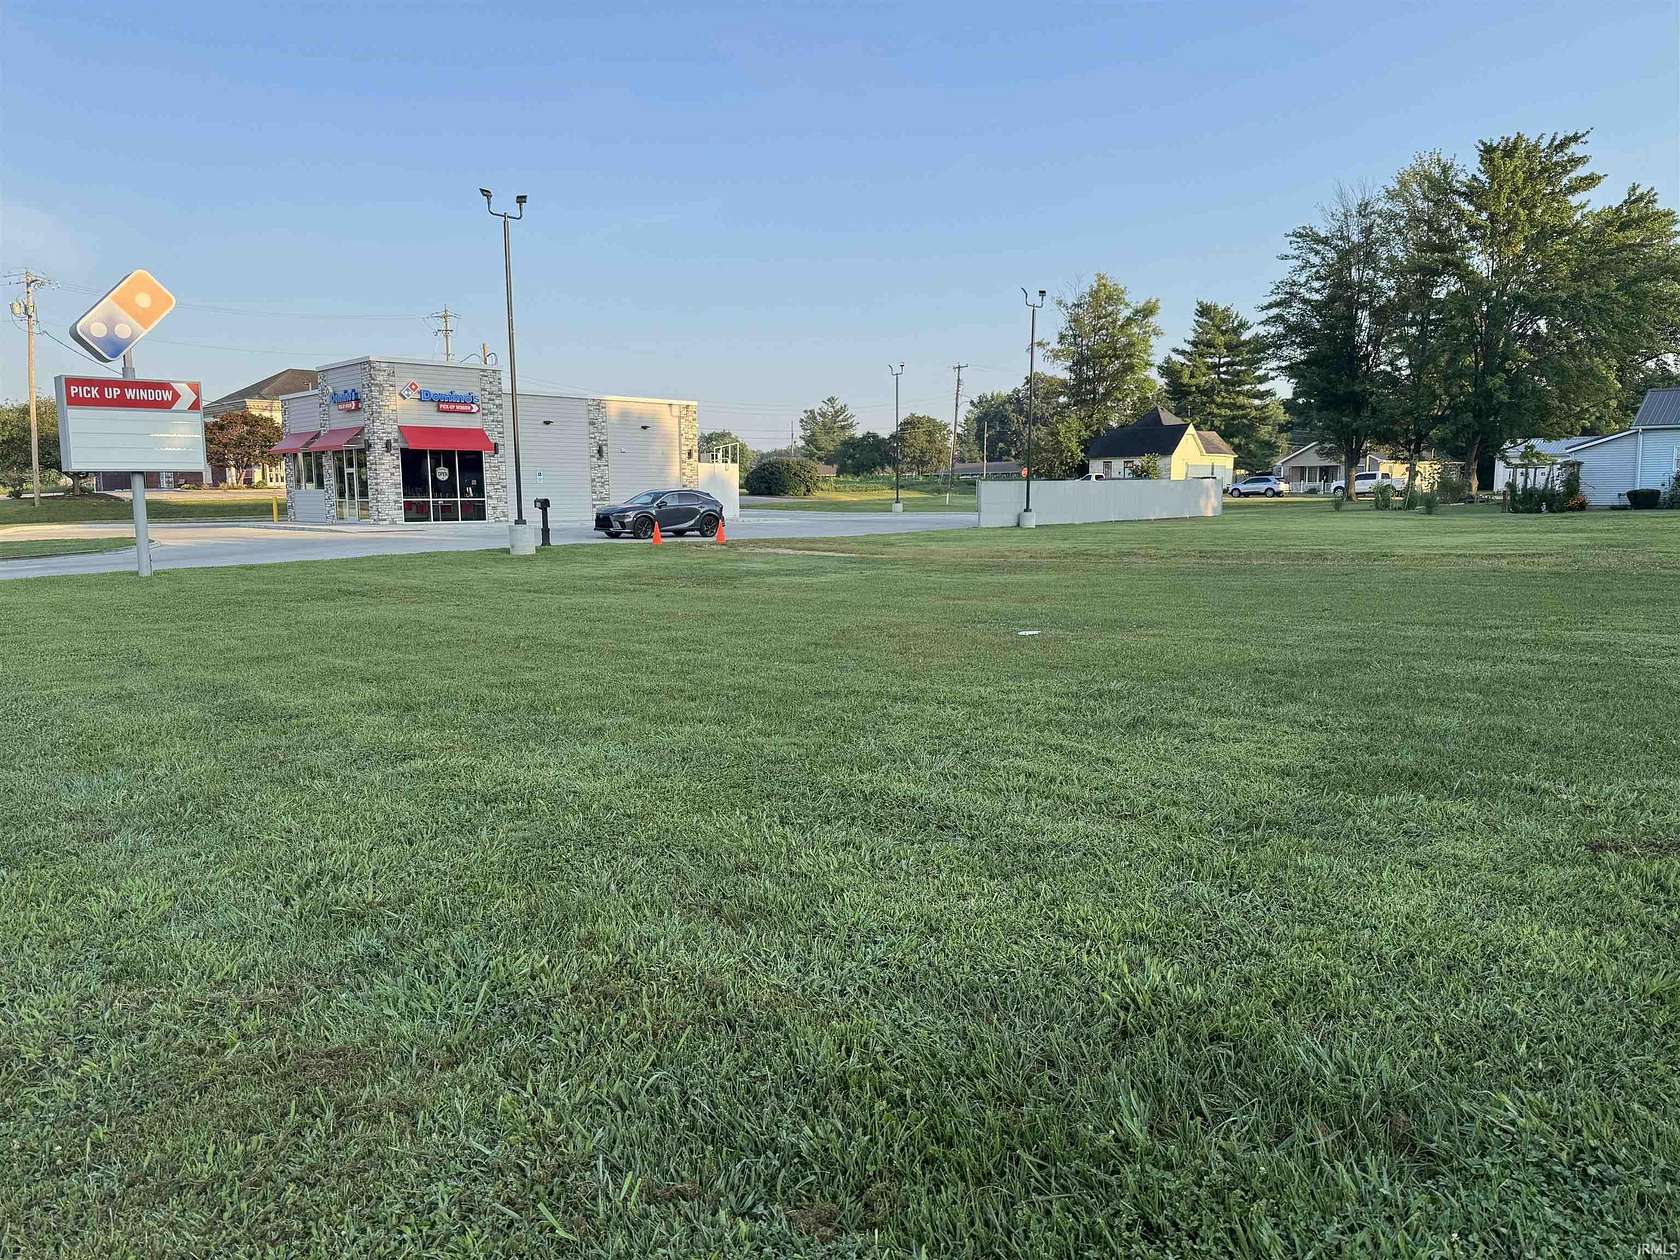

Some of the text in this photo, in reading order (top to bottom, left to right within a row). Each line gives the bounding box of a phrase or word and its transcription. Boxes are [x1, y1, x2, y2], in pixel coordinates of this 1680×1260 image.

[70, 385, 173, 401] PICK UP WINDOW
[420, 388, 480, 404] Domino's
